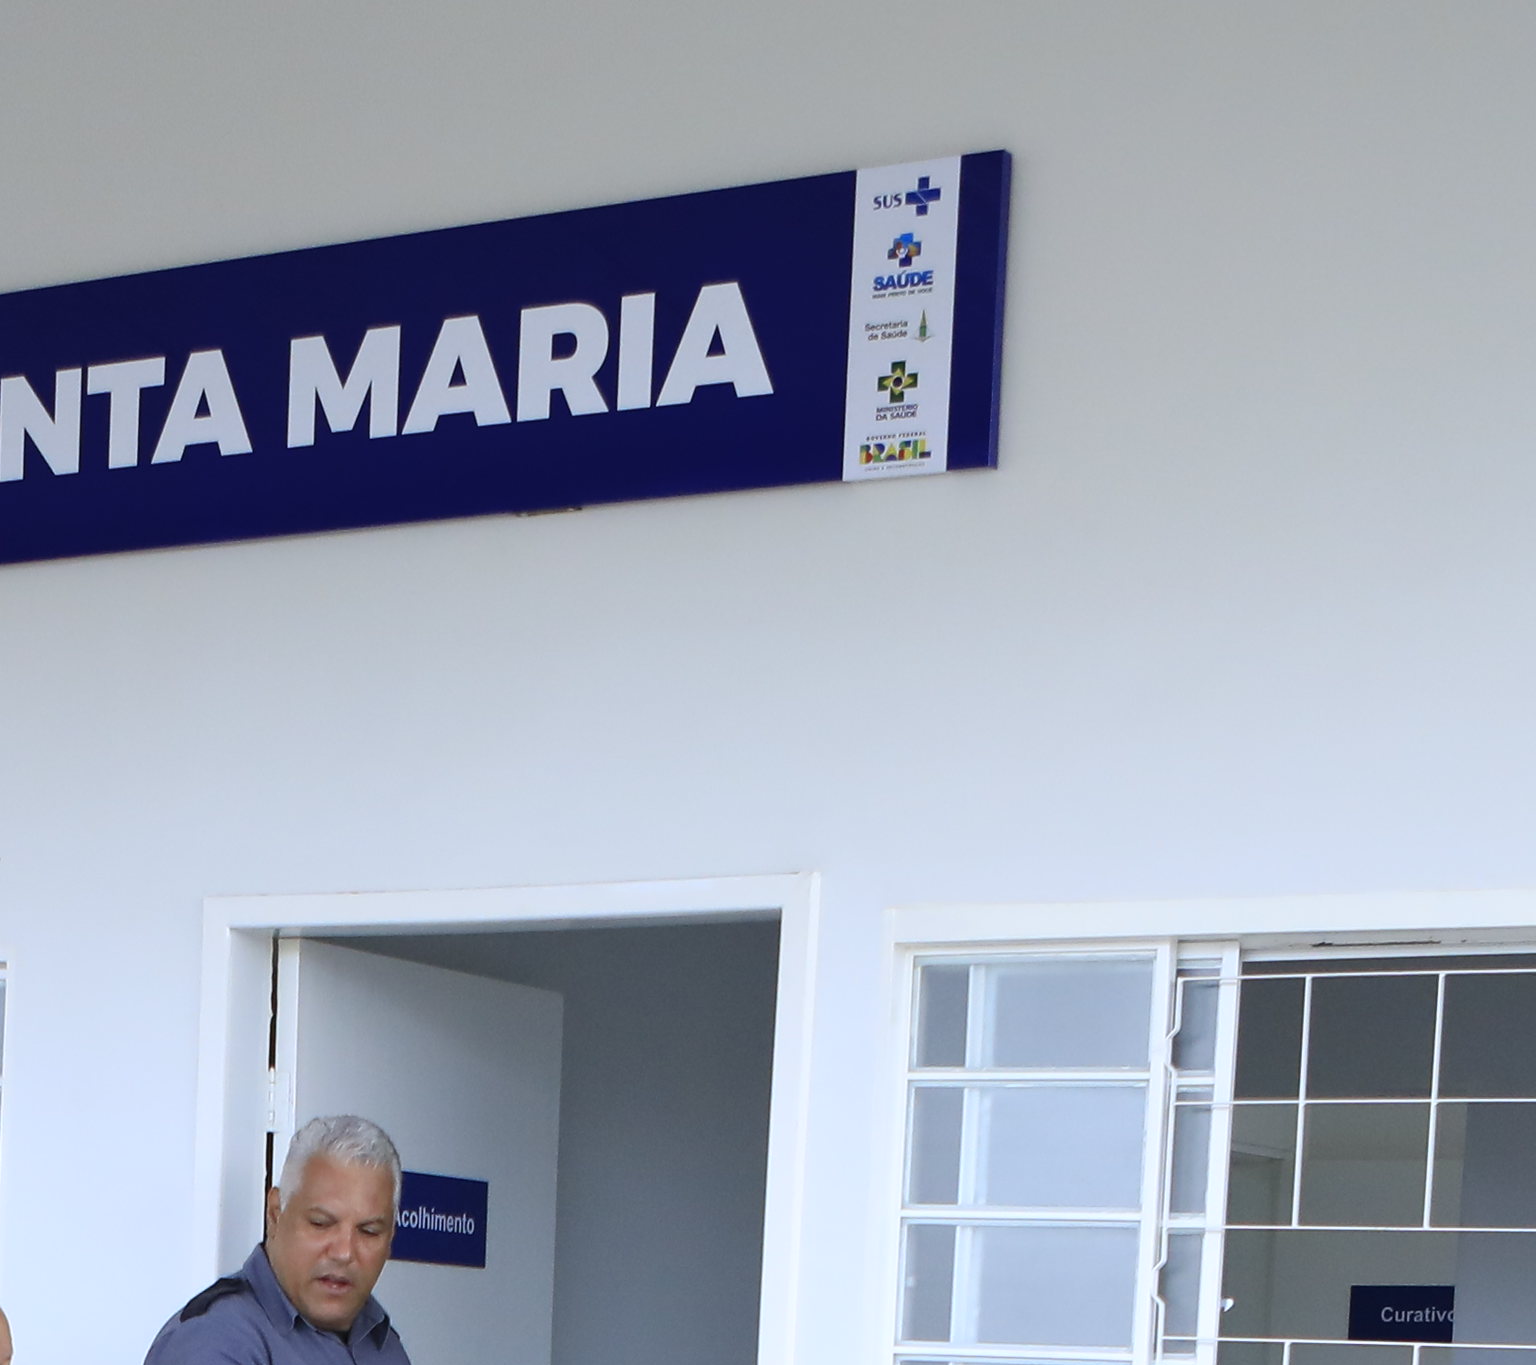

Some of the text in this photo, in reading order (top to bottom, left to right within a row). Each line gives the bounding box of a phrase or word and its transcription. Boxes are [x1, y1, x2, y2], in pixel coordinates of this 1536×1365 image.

[873, 193, 903, 210] SUS
[873, 269, 934, 292] SAÚDE
[864, 320, 909, 331] Secretaria
[868, 330, 908, 341] de Saúde
[286, 281, 774, 448] MARIA
[859, 438, 932, 465] BRASIL
